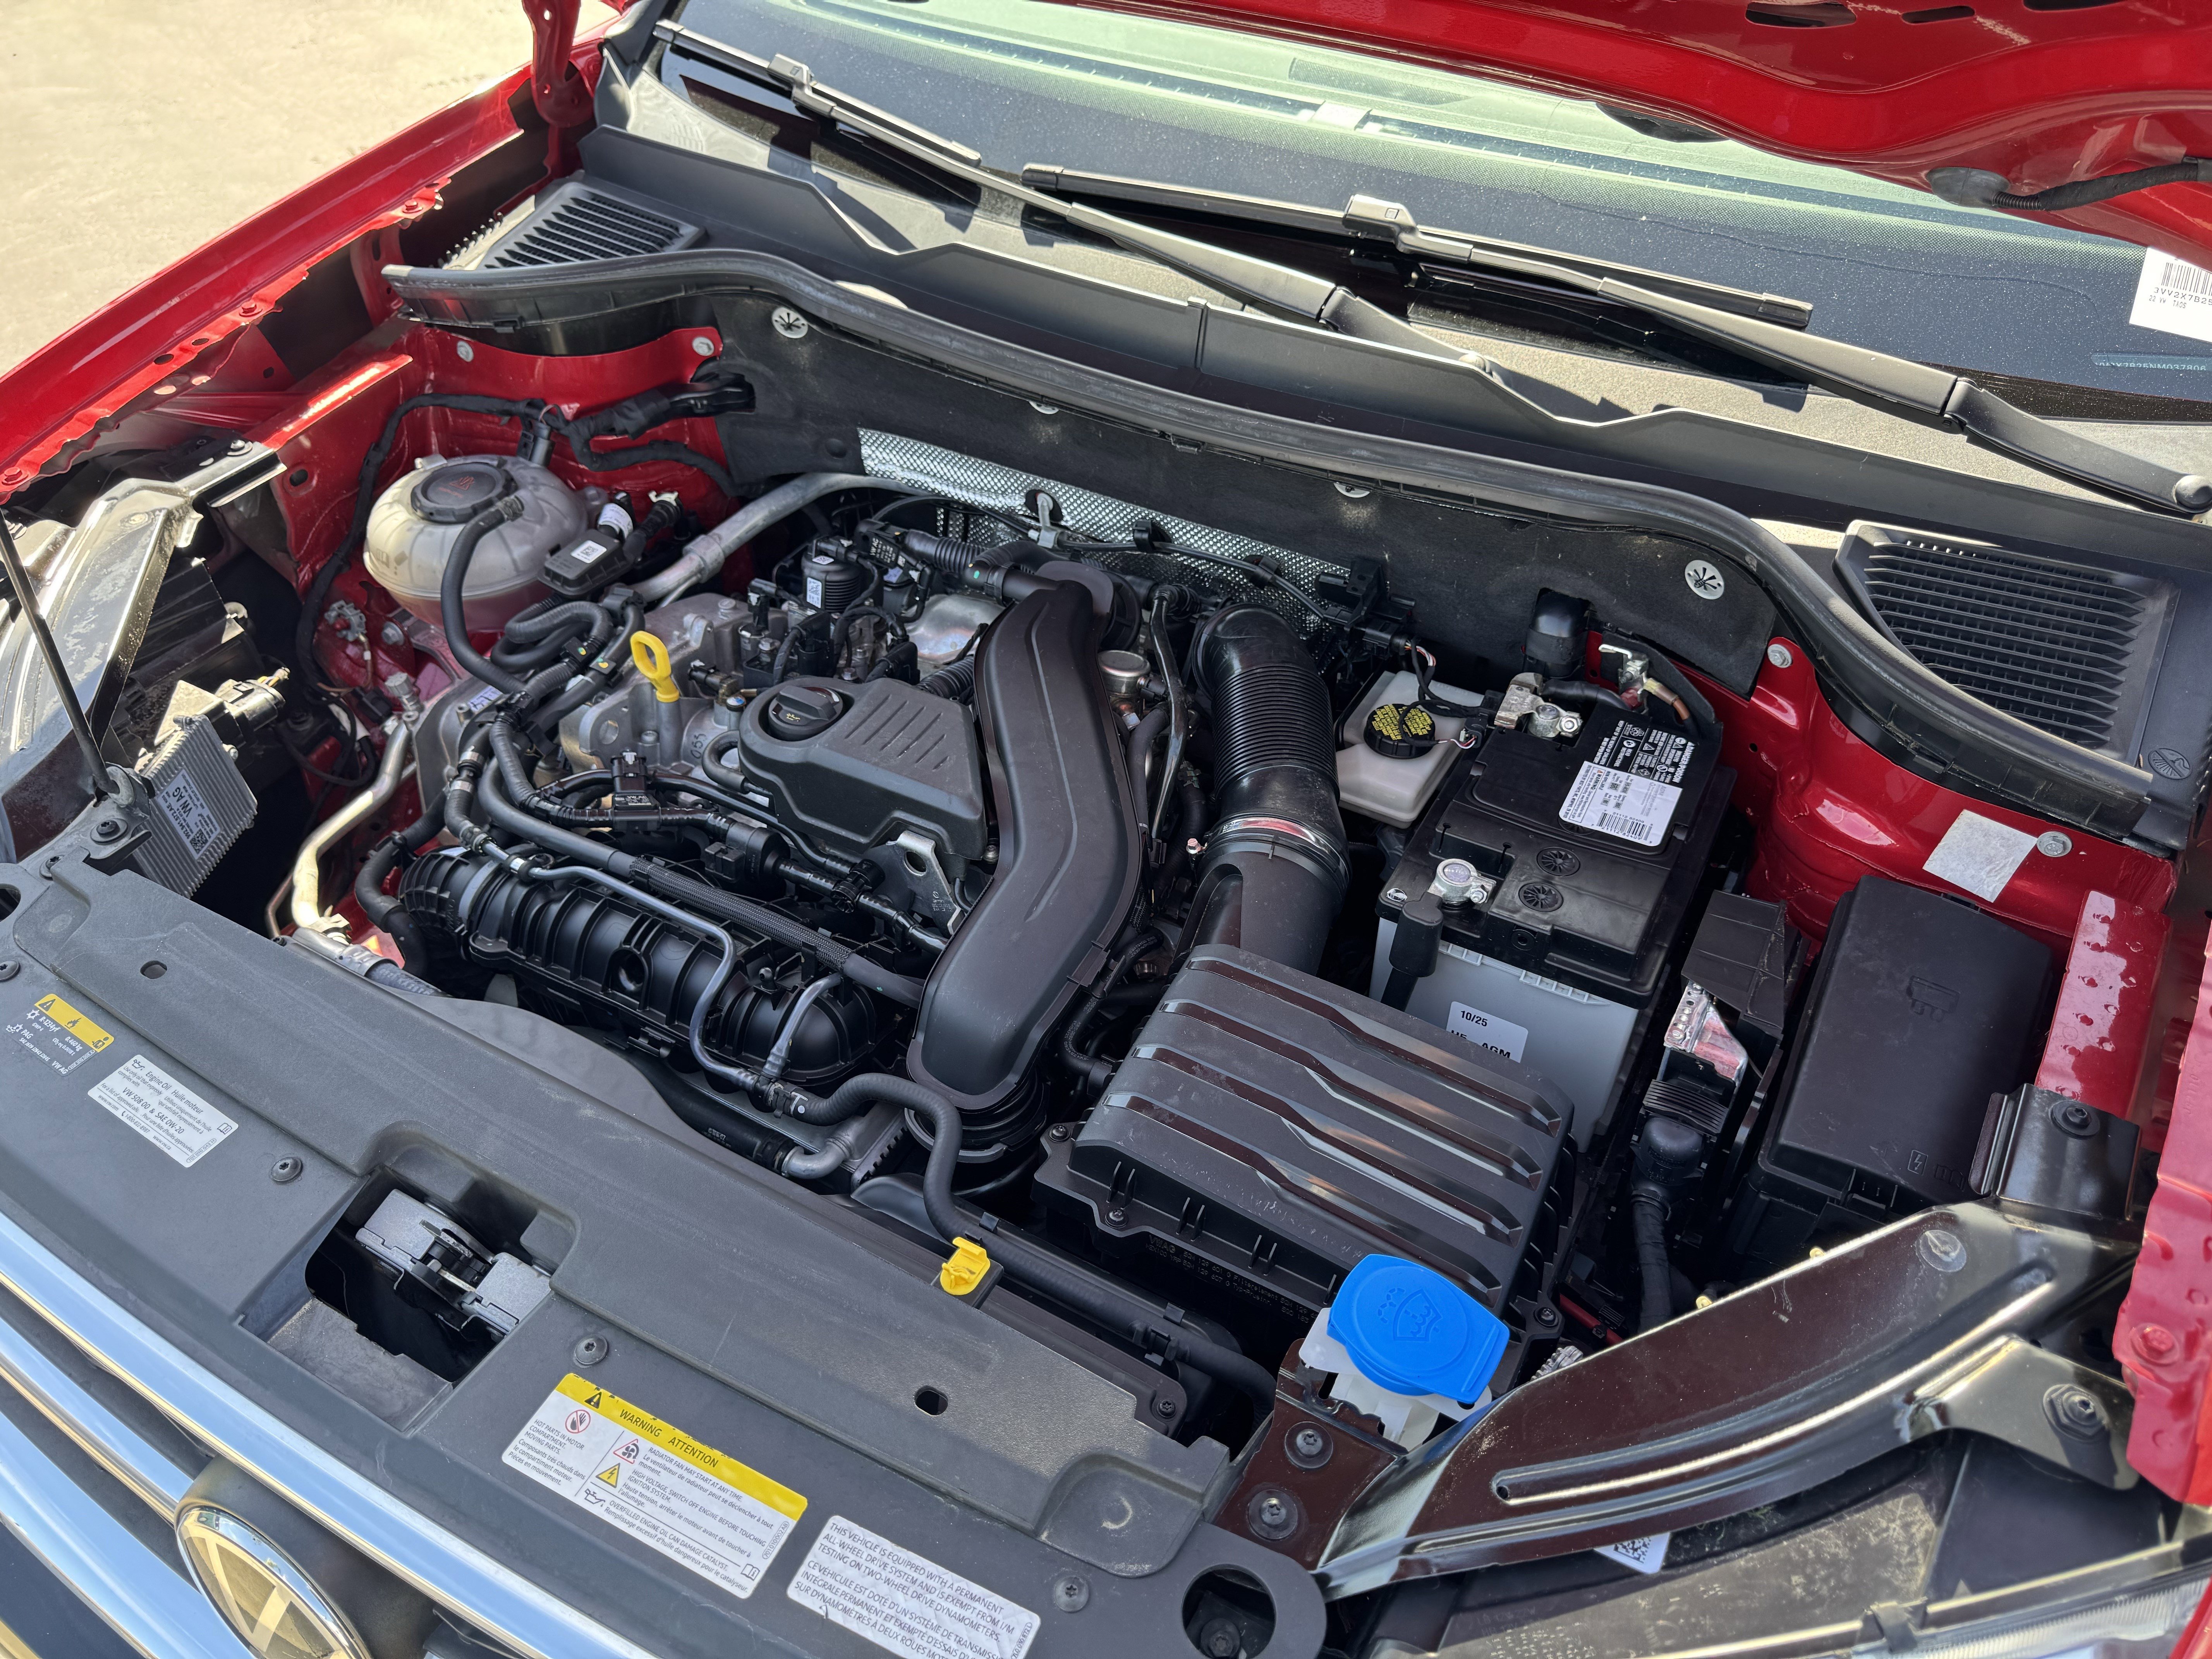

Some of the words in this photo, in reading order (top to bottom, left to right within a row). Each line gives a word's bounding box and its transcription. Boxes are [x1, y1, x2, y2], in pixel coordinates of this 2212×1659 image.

[2173, 300, 2186, 308] TAOS
[1672, 745, 1694, 783] DANGER/POISON
[172, 787, 185, 802] AG
[179, 799, 192, 817] VW
[21, 1029, 33, 1039] PAG
[39, 1016, 61, 1032] R-1234yf
[1461, 1011, 1487, 1027] 10/25
[65, 1036, 78, 1046] 0.460
[52, 1061, 62, 1069] VW
[145, 1071, 163, 1085] Engine
[171, 1089, 185, 1101] Huile
[184, 1100, 203, 1114] moteur
[122, 1087, 135, 1097] VW
[131, 1094, 143, 1104] 508
[155, 1112, 168, 1122] SAE
[165, 1119, 184, 1133] 0W-20
[1198, 1267, 1208, 1276] 129
[1211, 1274, 1223, 1282] 607
[1199, 1258, 1209, 1267] 129
[1212, 1266, 1222, 1274] 601
[524, 1431, 545, 1445] MOVING
[544, 1442, 560, 1455] PARTS.
[529, 1425, 566, 1449] COMPARTMENT.
[534, 1419, 546, 1427] HOT
[544, 1425, 561, 1436] PARTS
[565, 1437, 584, 1450] MOTOR
[620, 1409, 662, 1437] WARNING
[668, 1437, 719, 1468] ATTENTION
[508, 1451, 524, 1463] Pièces
[531, 1465, 561, 1485] mouvement.
[519, 1439, 548, 1458] Composants
[547, 1455, 557, 1463] très
[556, 1461, 574, 1473] chauds
[573, 1470, 586, 1480] dans
[519, 1449, 553, 1471] compartiment
[553, 1468, 572, 1482] moteur.
[638, 1461, 661, 1476] moment.
[648, 1447, 674, 1464] RADIATOR
[673, 1461, 685, 1470] FAN
[684, 1466, 696, 1475] MAY
[695, 1473, 712, 1484] START
[717, 1485, 730, 1494] ANY
[729, 1491, 742, 1502] TIME.
[618, 1488, 644, 1507] l'allumage.
[627, 1475, 651, 1491] IGNITION
[650, 1487, 671, 1503] SYSTEM.
[650, 1458, 678, 1476] ventilateur
[685, 1478, 709, 1493] radiateur
[708, 1491, 721, 1500] peut
[728, 1501, 757, 1519] déclencher
[761, 1519, 773, 1529] tout
[622, 1482, 638, 1494] Haute
[638, 1492, 658, 1507] tension,
[659, 1504, 678, 1516] arrêter
[683, 1517, 703, 1530] moteur
[702, 1528, 718, 1539] avant
[726, 1540, 747, 1555] toucher
[632, 1469, 646, 1479] HIGH
[645, 1476, 668, 1493] VOLTAGE,
[668, 1489, 689, 1503] SWITCH
[688, 1500, 699, 1508] OFF
[698, 1506, 719, 1520] ENGINE
[718, 1517, 739, 1532] BEFORE
[739, 1528, 766, 1547] TOUCHING
[604, 1506, 636, 1528] Remplissage
[636, 1526, 658, 1539] excessif
[656, 1537, 674, 1550] d'huile
[674, 1547, 701, 1565] dangereux
[700, 1563, 714, 1572] pour
[720, 1574, 747, 1592] catalyseur.
[609, 1500, 640, 1520] OVERFILLED
[640, 1517, 660, 1532] ENGINE
[659, 1528, 668, 1537] OIL
[668, 1534, 680, 1543] CAN
[679, 1540, 703, 1556] DAMAGE
[702, 1553, 728, 1571] CATALYST.
[823, 1533, 864, 1559] ALL-WHEEL
[865, 1554, 889, 1571] DRIVE
[888, 1566, 918, 1585] SYSTEM
[917, 1581, 937, 1594] AND
[936, 1590, 945, 1599] IS
[945, 1594, 977, 1614] EXEMPT
[976, 1610, 1000, 1627] FROM
[1000, 1621, 1015, 1634] I/M
[830, 1522, 848, 1536] THIS
[848, 1531, 879, 1552] VEHICLE
[879, 1547, 887, 1556] IS
[887, 1551, 926, 1575] EQUIPPED
[926, 1570, 948, 1587] WITH
[947, 1582, 953, 1591] A
[955, 1586, 1004, 1614] PERMANENT
[808, 1560, 819, 1570] CE
[819, 1565, 854, 1589] VÉHICULE
[853, 1583, 869, 1595] EST
[867, 1590, 889, 1606] DOTÉ
[888, 1601, 909, 1617] D'UN
[908, 1612, 942, 1634] SYSTÈME
[941, 1628, 954, 1640] DE
[818, 1542, 849, 1564] TESTING
[849, 1559, 863, 1571] ON
[863, 1566, 910, 1595] TWO-WHEEL
[910, 1590, 936, 1608] DRIVE
[934, 1602, 1000, 1642] DYNAMOMETERS.
[794, 1581, 811, 1594] SUR
[810, 1589, 872, 1626] DYNAMOMÈTRES
[870, 1621, 877, 1630] À
[878, 1624, 901, 1641] DEUX
[900, 1635, 927, 1654] ROUES
[801, 1570, 840, 1595] INTÉGRALE
[839, 1590, 885, 1618] PERMANENT
[883, 1613, 896, 1623] ET
[893, 1618, 927, 1640] EXEMPTÉ
[926, 1635, 959, 1657] D'ESSAIS
